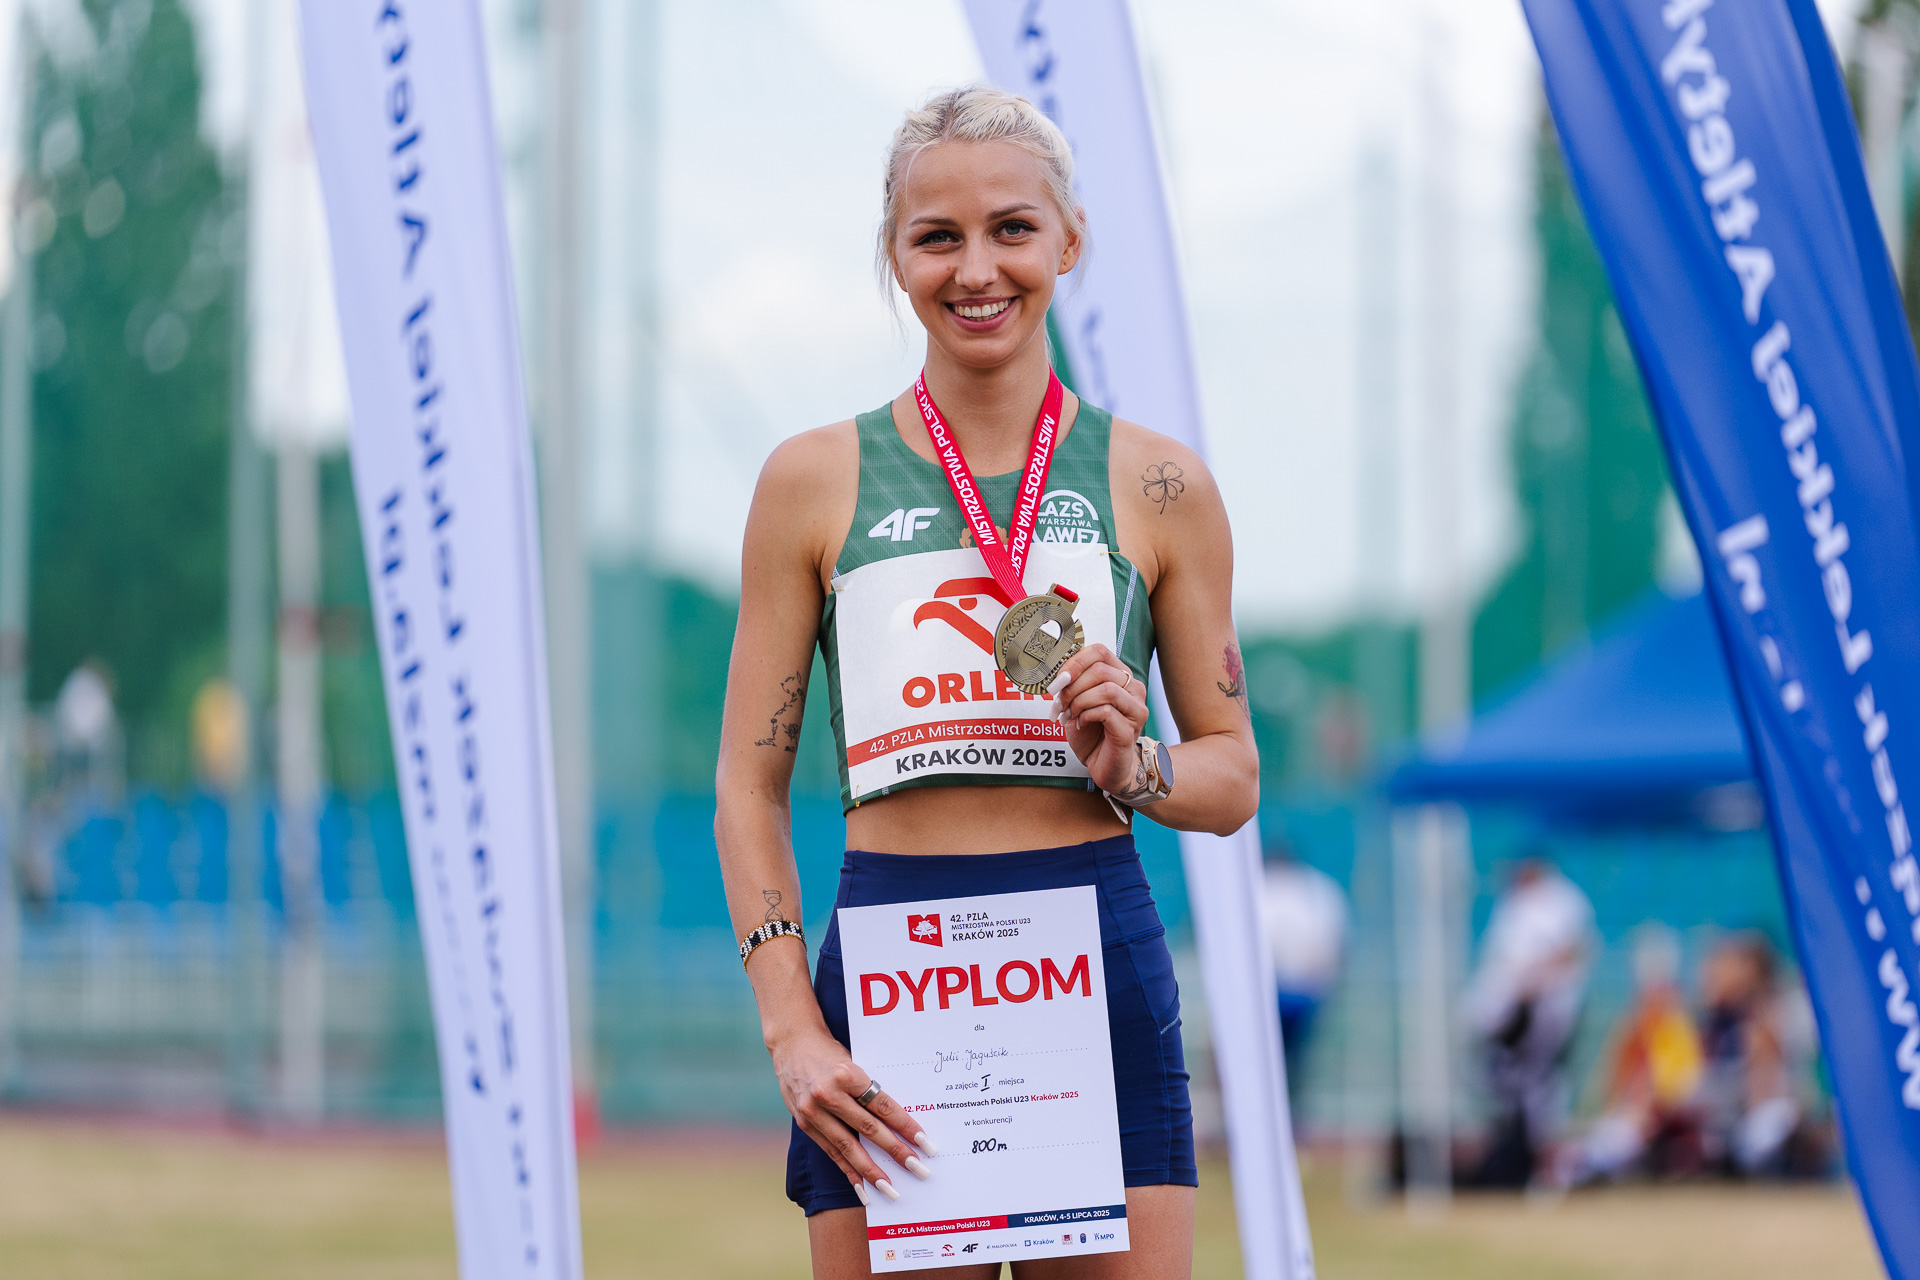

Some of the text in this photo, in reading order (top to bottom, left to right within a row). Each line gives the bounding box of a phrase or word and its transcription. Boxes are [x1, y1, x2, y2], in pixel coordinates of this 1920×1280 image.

[920, 394, 951, 448] POLSKI
[1017, 414, 1055, 528] MISTRZOSTWA
[943, 446, 997, 546] MISTRZOSTWA
[1040, 501, 1084, 518] AZS
[868, 507, 940, 541] 4F
[1038, 518, 1092, 528] WARSZAWA
[869, 723, 1064, 754] 42. PZLA Mistrzostwa Polski
[896, 743, 1067, 775] KRAKÓW 2025
[950, 912, 989, 923] 42. PZLA
[951, 921, 995, 930] MISTRZOSTWA
[1019, 917, 1031, 925] U23
[952, 928, 1019, 941] KRAKÓW 2025
[859, 954, 1092, 1017] DYPLOM
[974, 1024, 985, 1032] dla
[955, 1081, 979, 1090] zajęcie
[998, 1078, 1025, 1086] miejsca
[915, 1103, 935, 1112] PZLA
[936, 1099, 990, 1110] Mistrzostwach
[990, 1096, 1013, 1106] Polski
[1014, 1095, 1030, 1103] U23
[1030, 1093, 1059, 1102] Kraków
[1060, 1091, 1079, 1100] 2025
[972, 1116, 1013, 1127] konkurencji
[1024, 1209, 1110, 1225] KRAKÓW, 4-5 LIPCA 2025
[886, 1219, 991, 1236] 42. PZLA Mistrzostwa Polski U23
[962, 1243, 979, 1253] 4F
